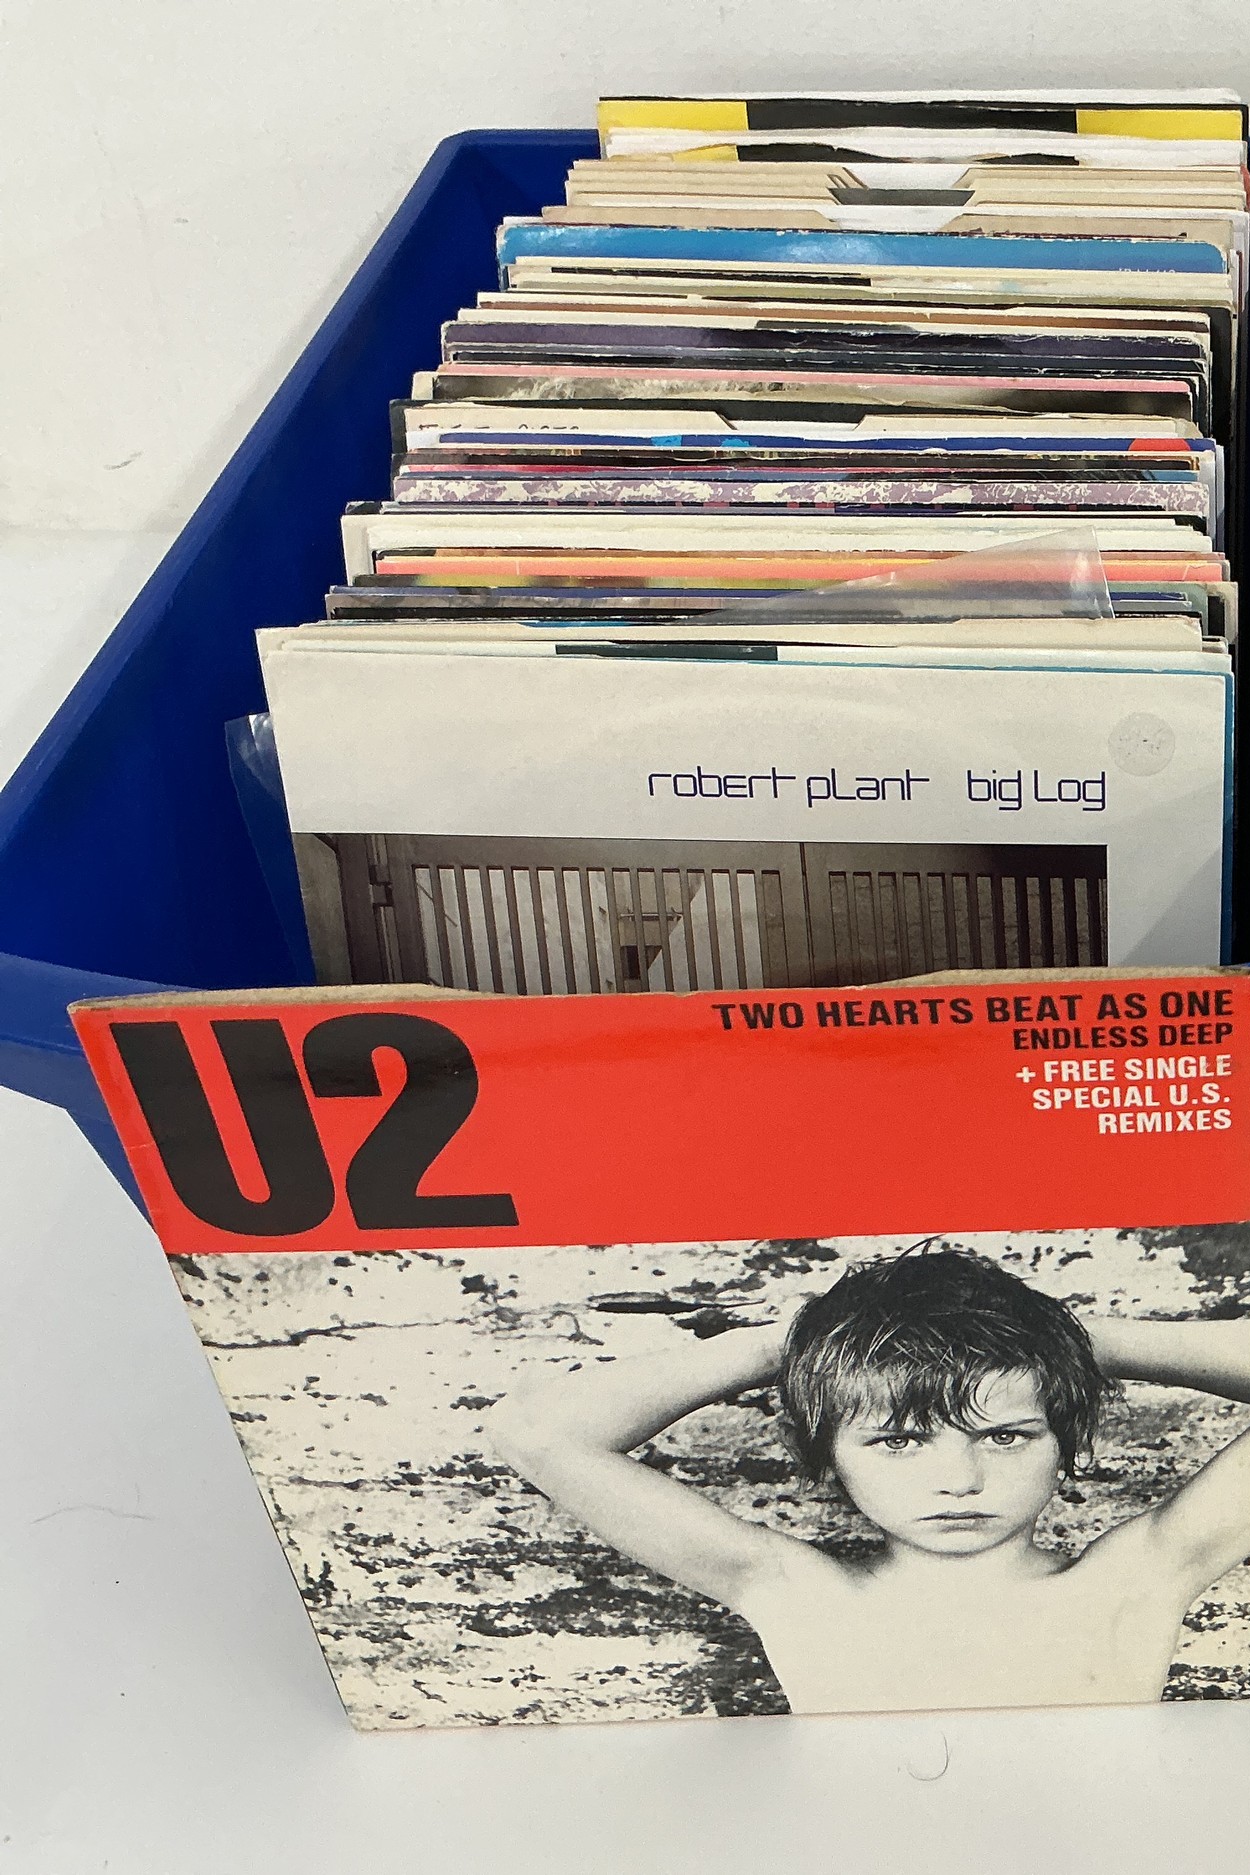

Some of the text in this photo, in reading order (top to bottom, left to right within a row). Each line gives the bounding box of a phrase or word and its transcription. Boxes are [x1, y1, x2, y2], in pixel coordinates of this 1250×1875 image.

[648, 766, 796, 799] robert
[967, 769, 1022, 811] big
[712, 989, 1233, 1031] TWO HEARTS BEAT AS ONE
[1013, 1023, 1234, 1050] ENDLESS DEEP
[1045, 1059, 1115, 1081] FREE
[1124, 1054, 1232, 1080] SINGLE
[1033, 1083, 1231, 1110] SPECIAL U.S.
[109, 1012, 520, 1237] U2
[1099, 1109, 1232, 1135] REMIXES
